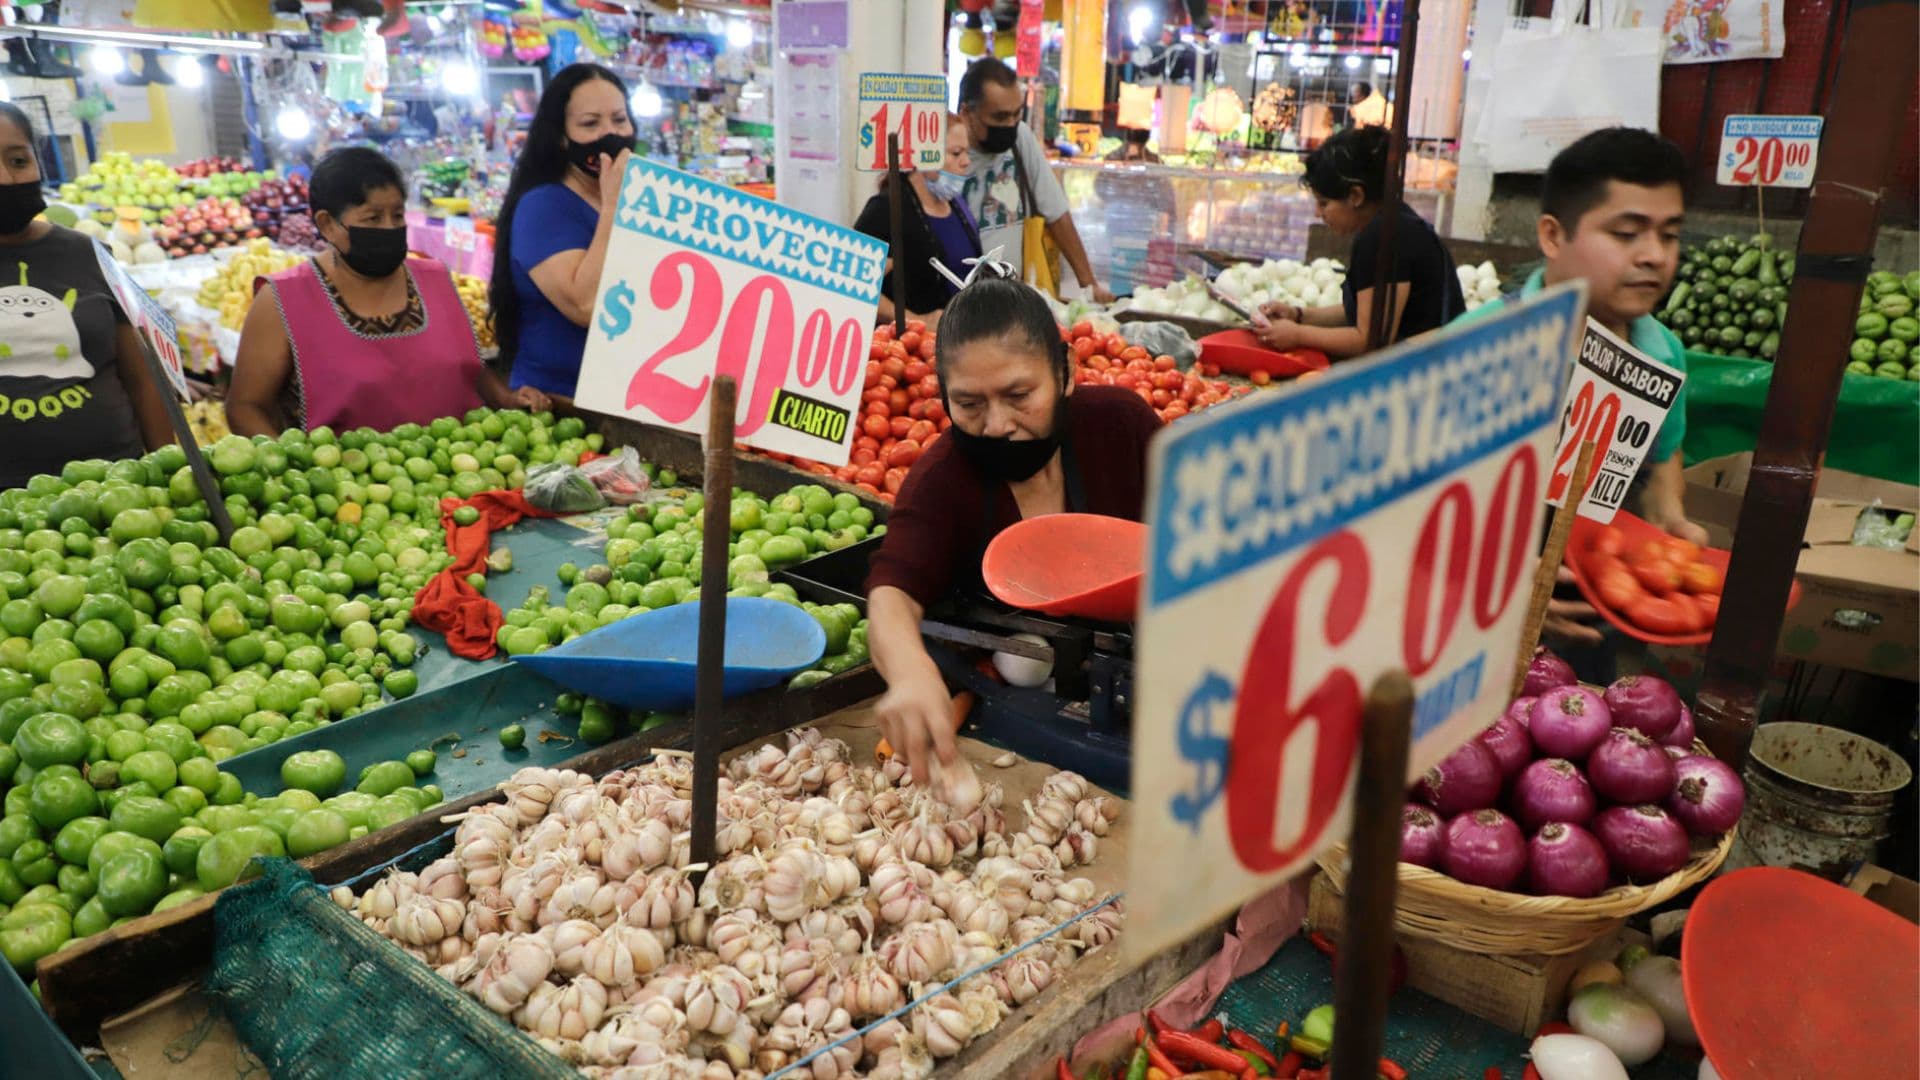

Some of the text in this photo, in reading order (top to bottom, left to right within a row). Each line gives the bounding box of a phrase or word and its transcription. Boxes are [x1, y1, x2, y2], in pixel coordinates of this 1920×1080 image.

[920, 150, 941, 163] KILO
[630, 184, 876, 285] APROVECHE
[1581, 335, 1674, 402] COLOR Y SABOR
[778, 396, 847, 440] CUARTO
[1605, 449, 1636, 469] PESOS
[1590, 472, 1626, 505] KILO
